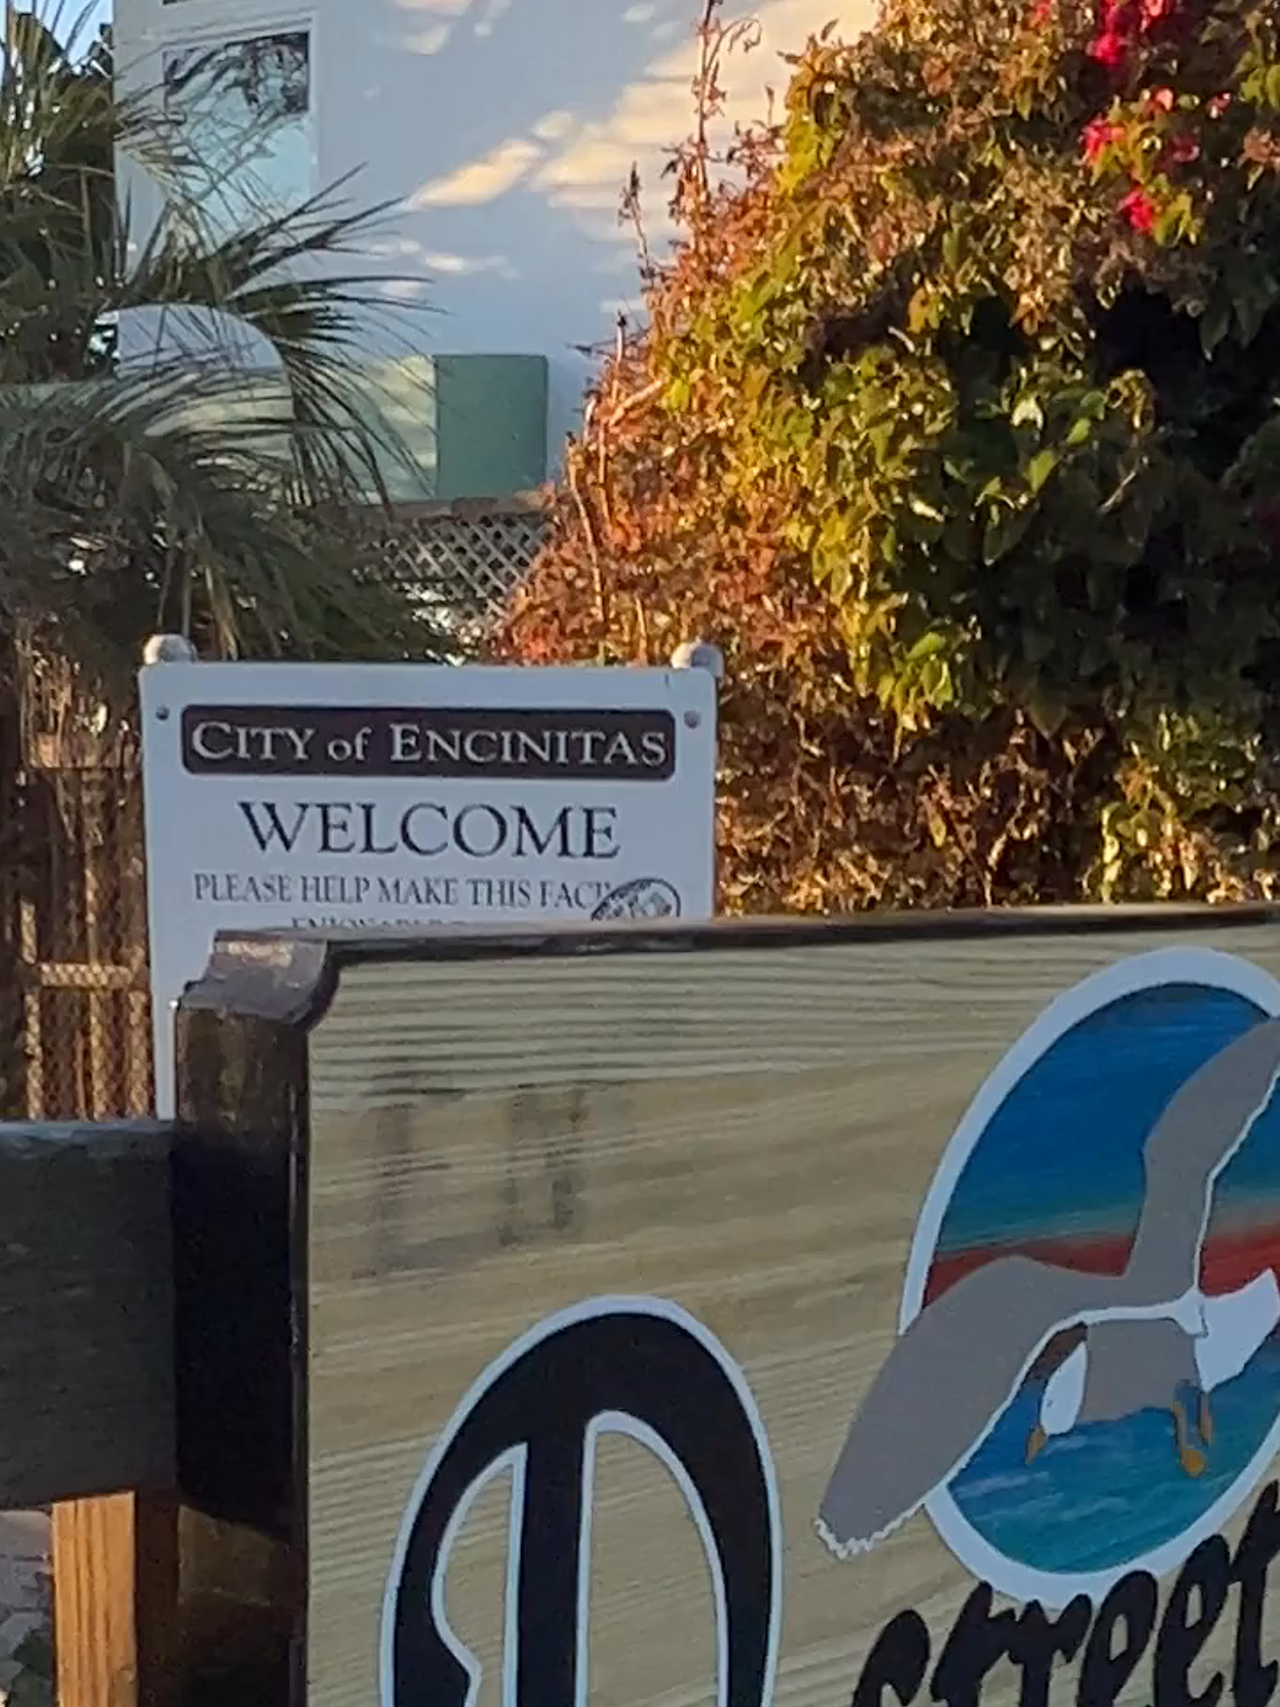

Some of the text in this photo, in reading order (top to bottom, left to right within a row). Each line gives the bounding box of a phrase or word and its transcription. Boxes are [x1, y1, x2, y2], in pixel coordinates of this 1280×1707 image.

[190, 720, 668, 765] CITY of ENCINITAS
[238, 800, 621, 859] WELCOME
[194, 872, 292, 904] PLEASE
[300, 874, 370, 904] HELP
[377, 876, 458, 906] MAKE
[469, 877, 531, 907] THIS
